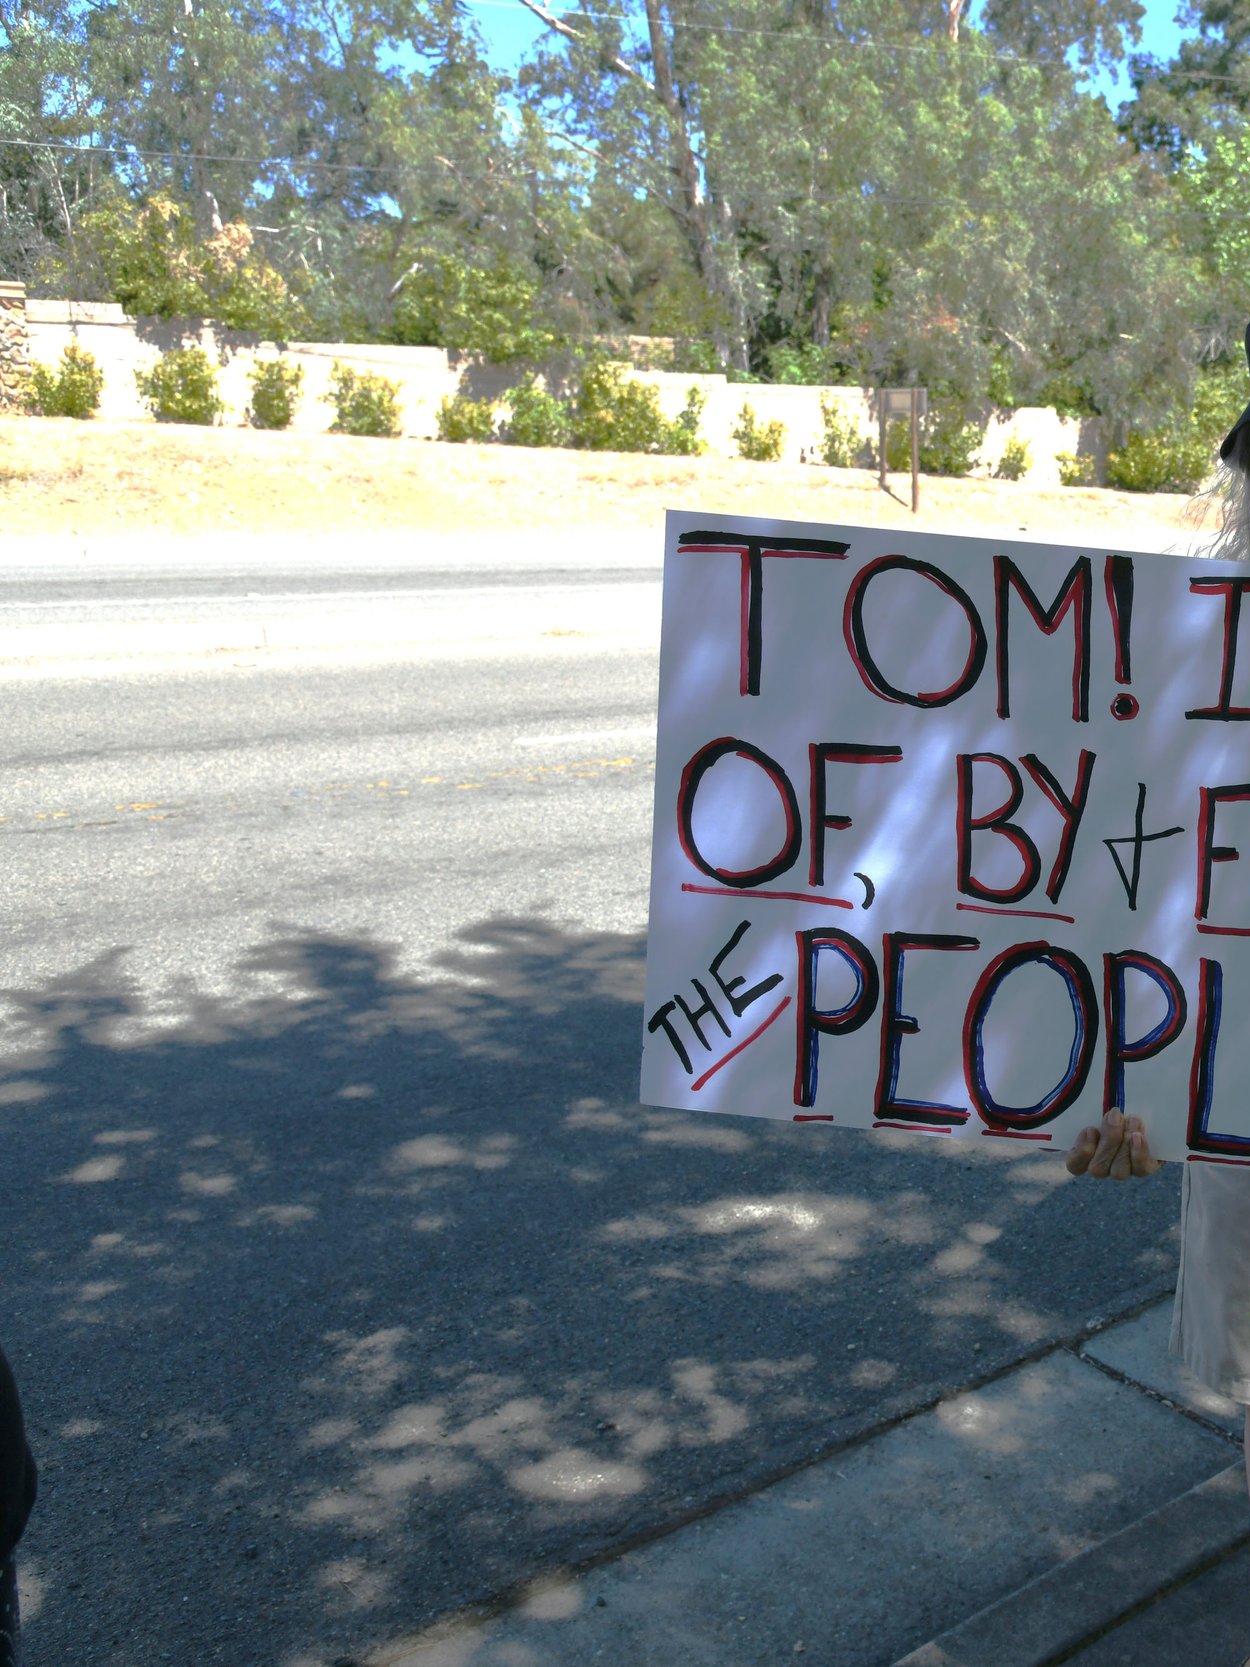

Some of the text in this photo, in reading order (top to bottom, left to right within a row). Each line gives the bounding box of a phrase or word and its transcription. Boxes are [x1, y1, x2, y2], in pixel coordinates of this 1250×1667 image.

[677, 531, 1140, 722] TOM!
[676, 736, 904, 910] OF,
[956, 748, 1097, 905] BY
[647, 919, 784, 1075] THE
